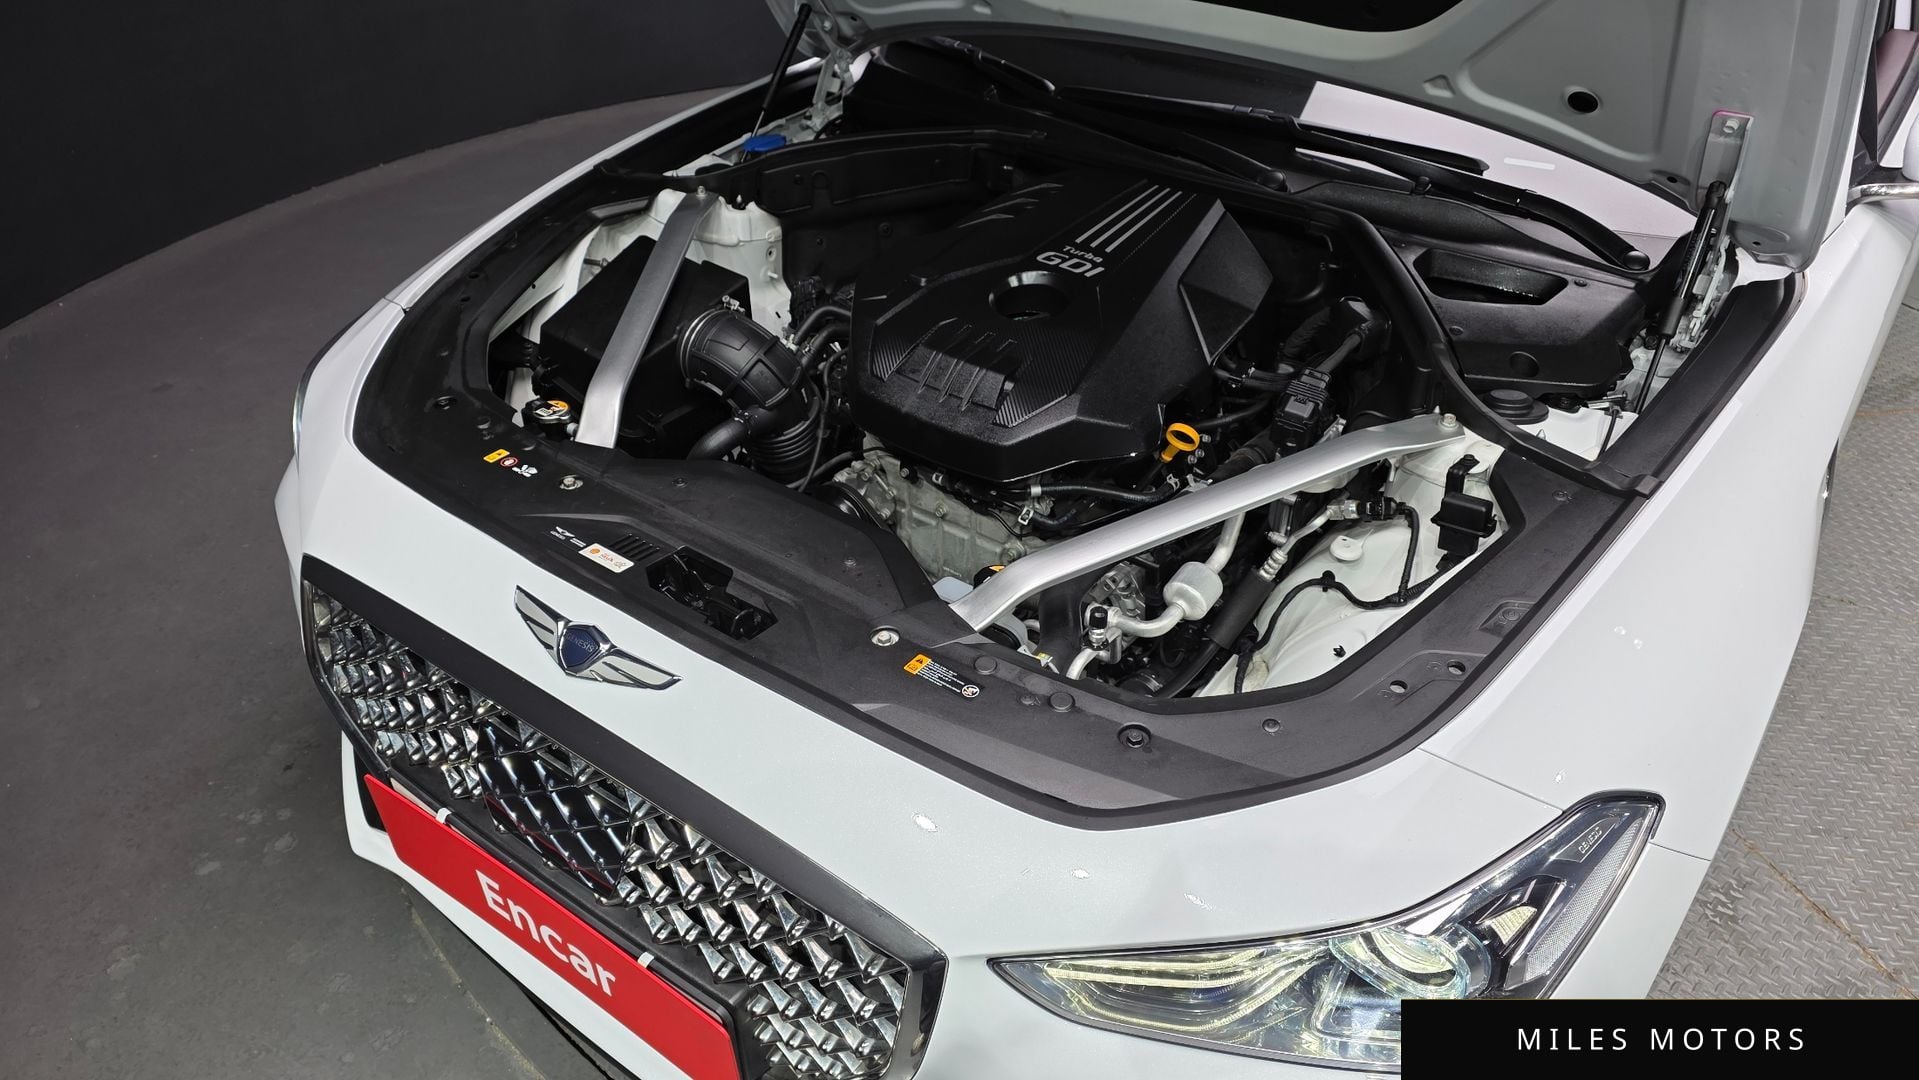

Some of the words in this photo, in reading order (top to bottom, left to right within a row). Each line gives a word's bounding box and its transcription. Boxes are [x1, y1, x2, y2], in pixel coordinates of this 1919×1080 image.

[1036, 251, 1105, 278] GDI
[1063, 245, 1104, 263] Turbo
[564, 631, 597, 654] GENESIS
[475, 869, 617, 997] Encar
